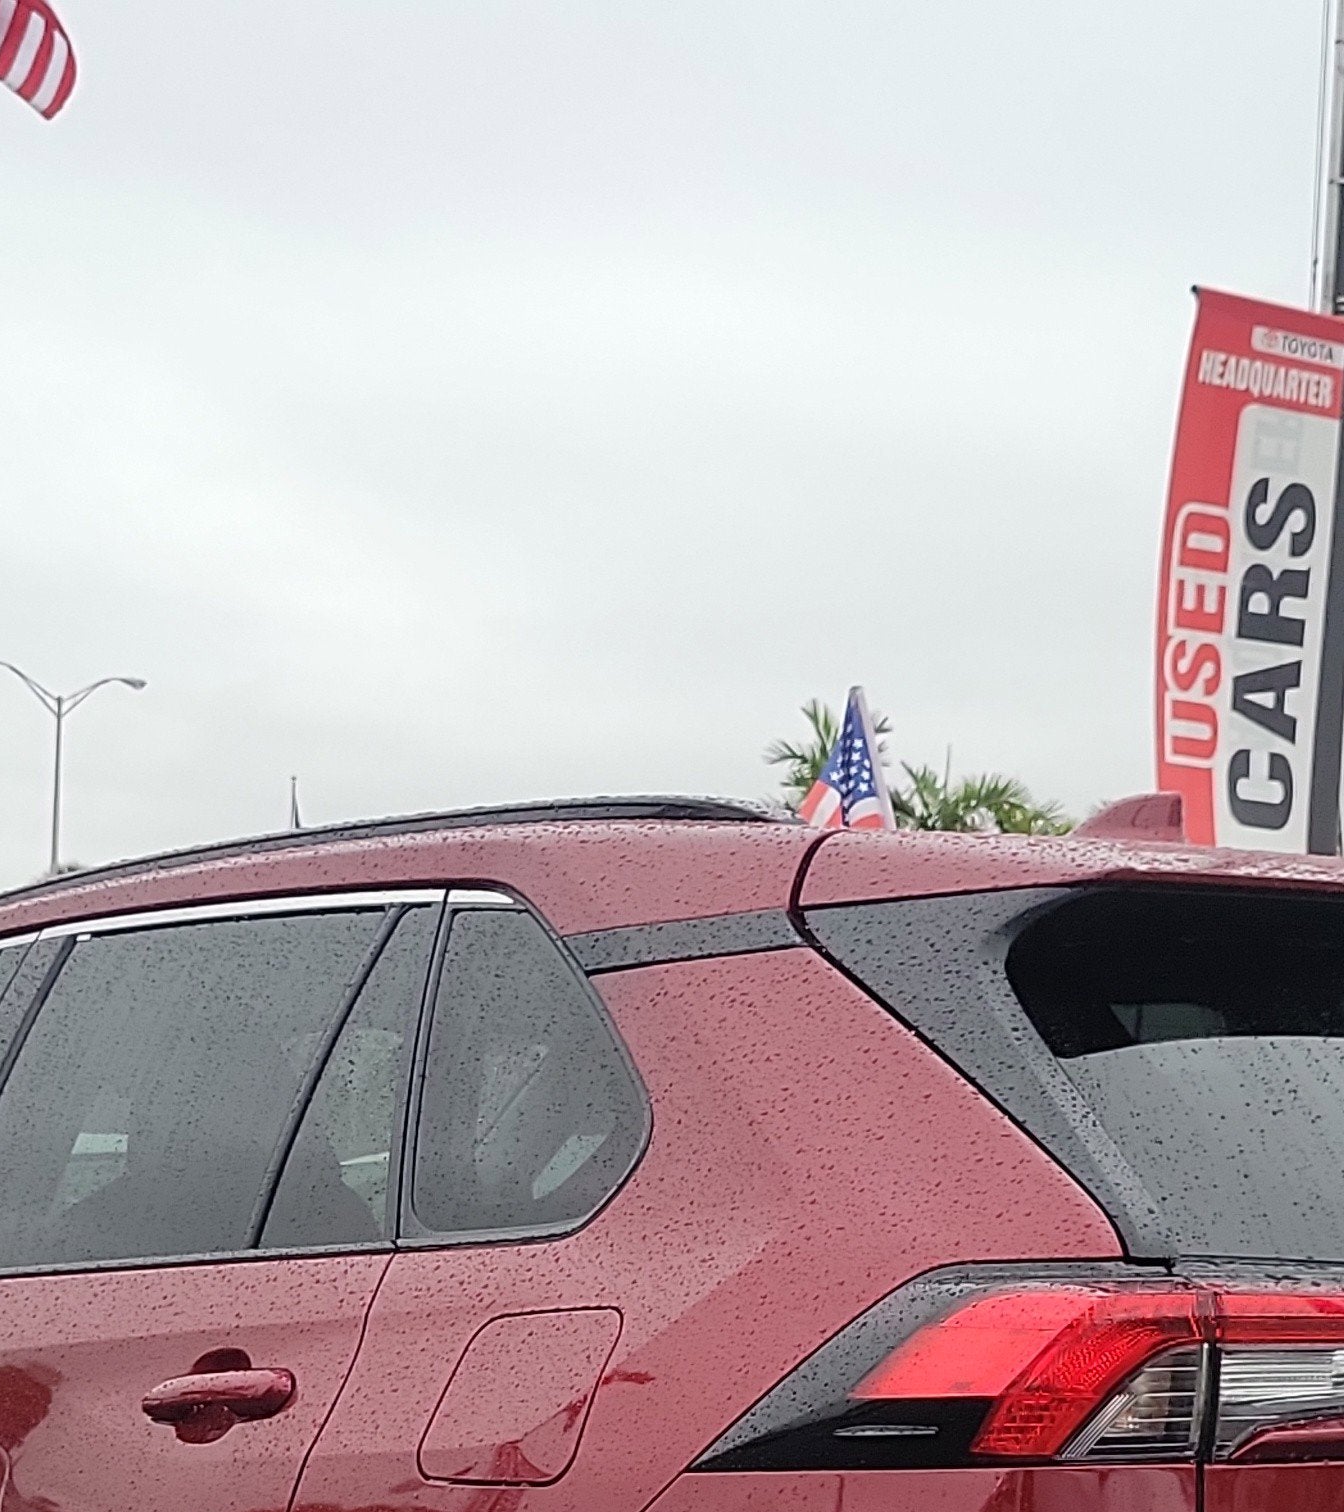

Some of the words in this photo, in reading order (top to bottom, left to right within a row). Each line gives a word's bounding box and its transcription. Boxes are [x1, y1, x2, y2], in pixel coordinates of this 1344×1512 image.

[1198, 350, 1334, 408] HEADQUARTER
[1281, 335, 1334, 361] TOYOTA
[1164, 502, 1231, 766] USED
[1227, 477, 1316, 830] CARS
